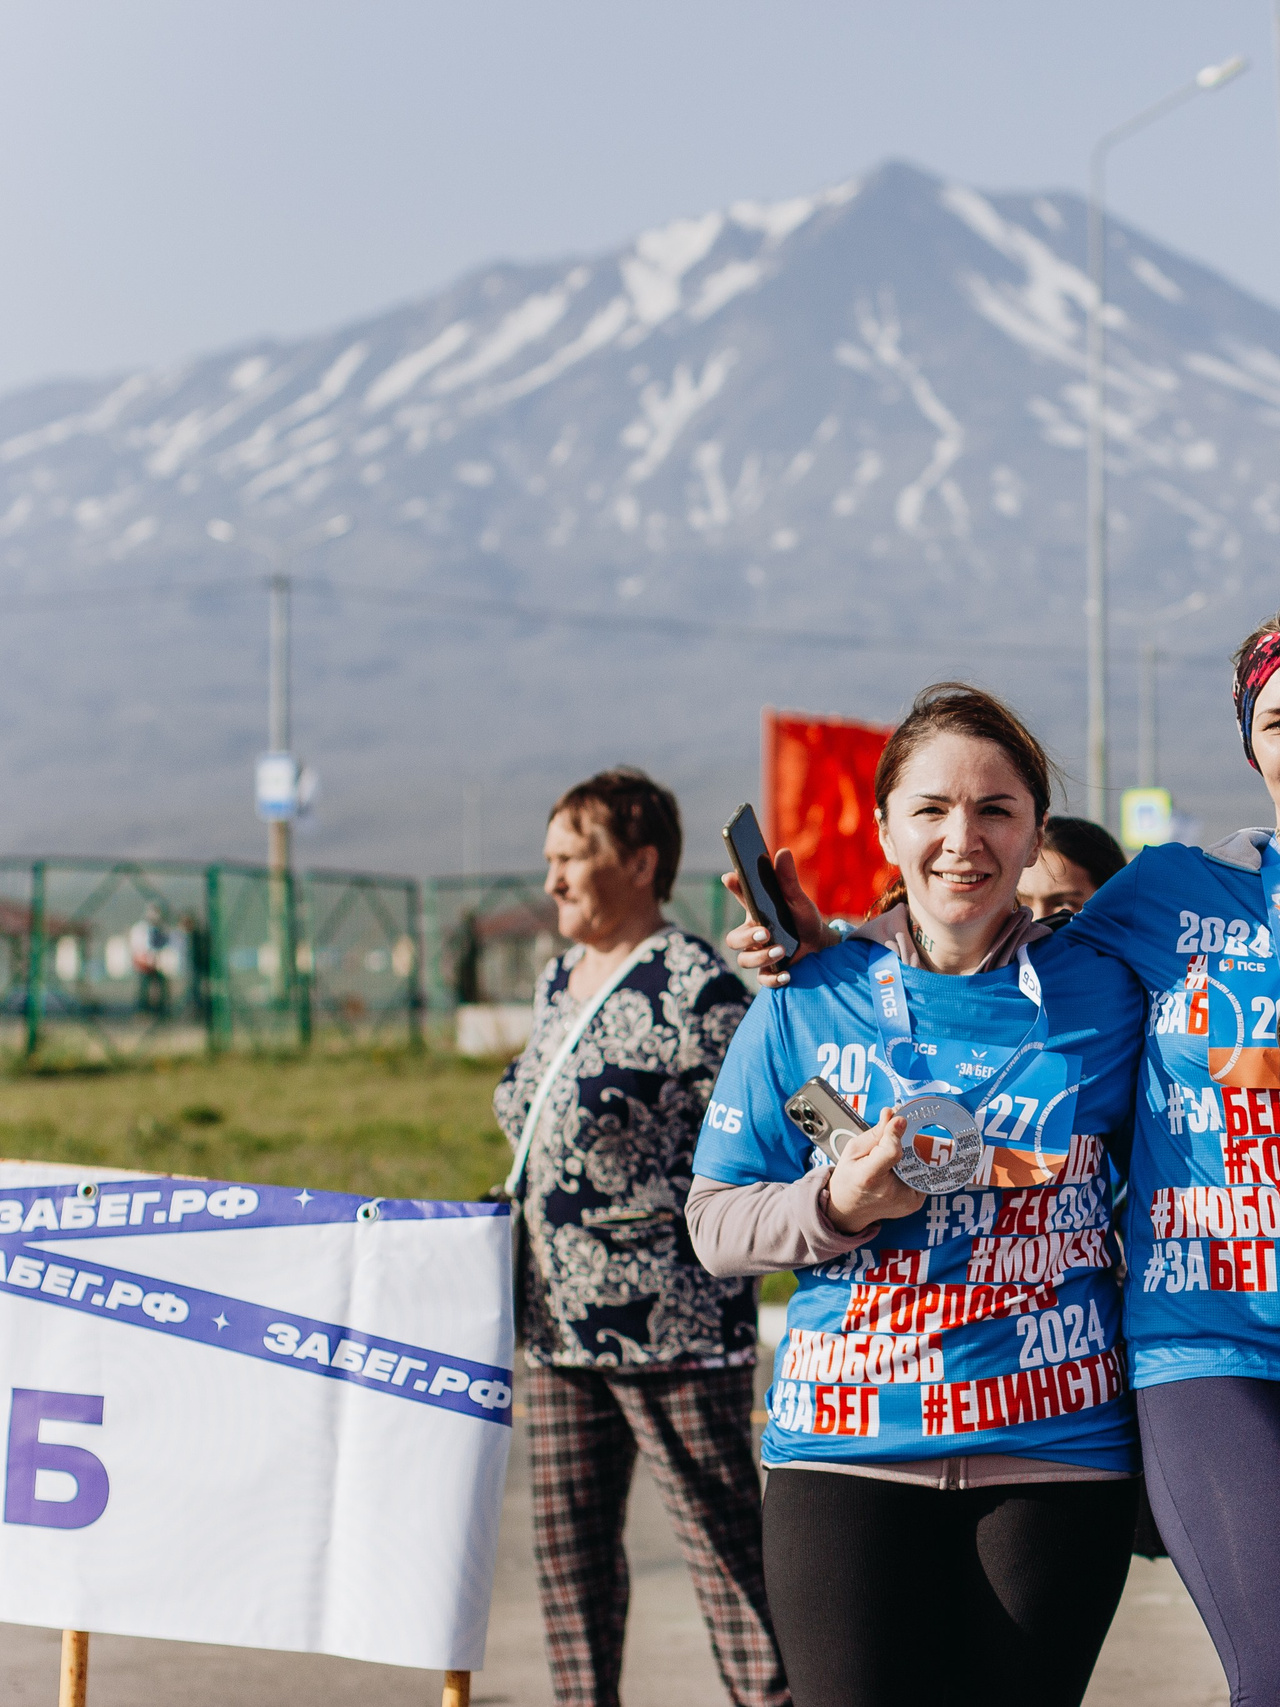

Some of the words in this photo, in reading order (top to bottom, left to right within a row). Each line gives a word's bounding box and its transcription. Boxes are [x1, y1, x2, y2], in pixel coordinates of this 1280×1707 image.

[1176, 910, 1273, 958] 2024
[1237, 960, 1266, 972] ПСБ
[880, 986, 899, 1018] ПСБ
[1148, 991, 1208, 1036] #ЗАБ
[818, 1043, 872, 1093] 20
[959, 1063, 973, 1077] ЗА
[976, 1093, 1039, 1141] 27
[0, 1187, 259, 1234] ЗАБЕГ.РФ
[0, 1252, 190, 1323] БЕГ.РФ
[1143, 1241, 1277, 1293] #ЗАБЕГ
[842, 1273, 1062, 1335] #ГОРДОСТЬ
[782, 1329, 944, 1384] #ЛЮБОВЬ
[1017, 1299, 1105, 1369] 2024
[263, 1323, 512, 1410] ЗАБЕГ.РФ
[773, 1381, 879, 1437] #ЗАБЕГ
[3, 1387, 109, 1530] Б
